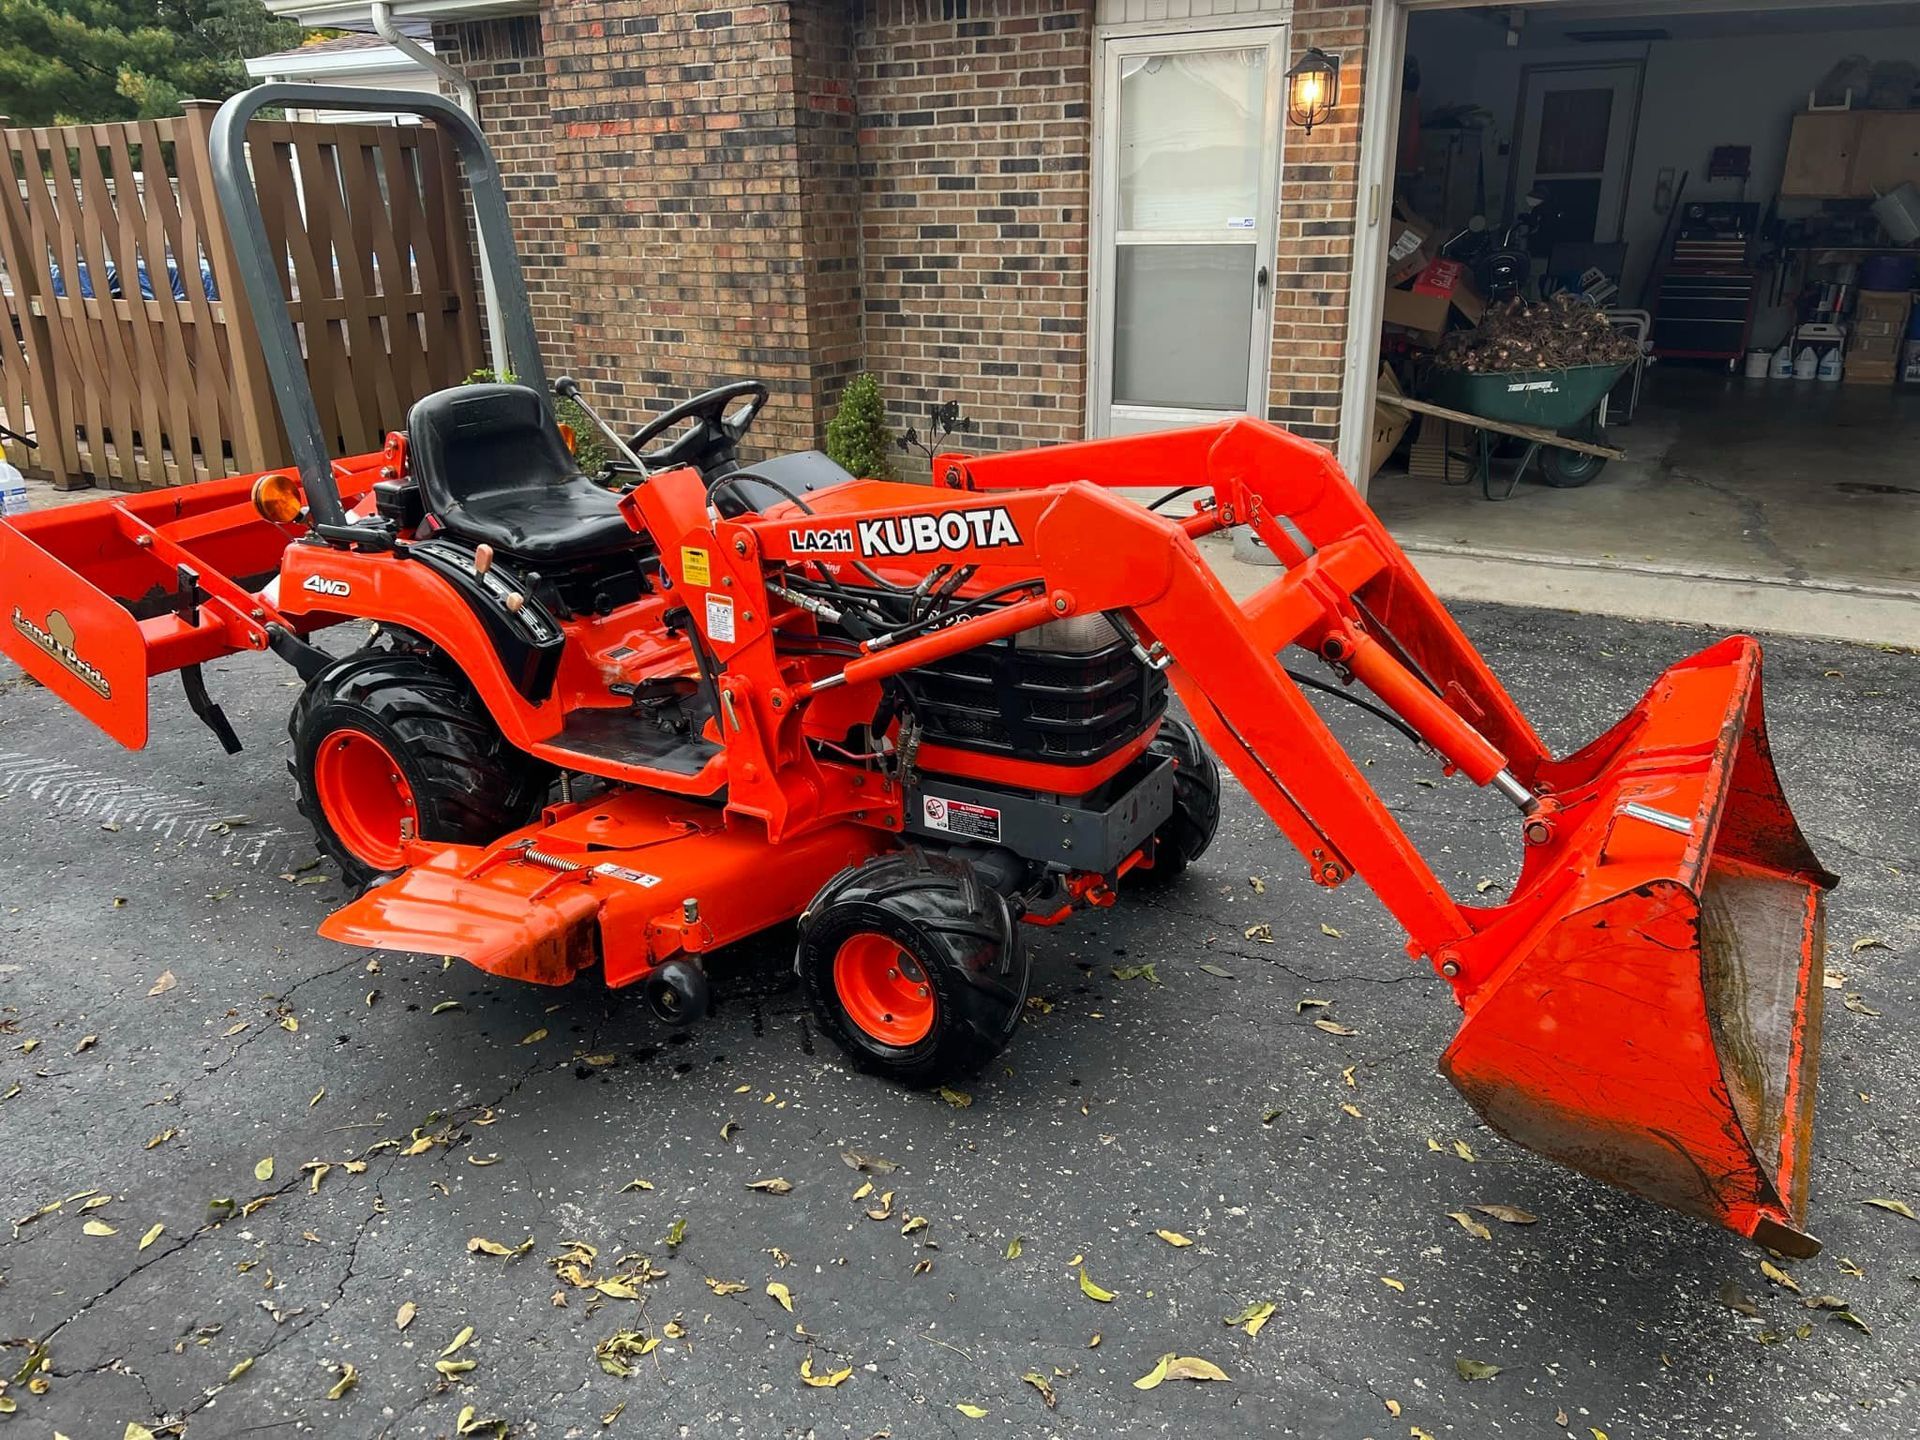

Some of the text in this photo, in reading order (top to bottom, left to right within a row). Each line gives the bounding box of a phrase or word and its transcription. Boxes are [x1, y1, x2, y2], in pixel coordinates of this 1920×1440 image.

[790, 507, 1022, 557] LA211 KUBOTA
[303, 574, 351, 597] 4WD
[14, 606, 110, 692] Land Pride
